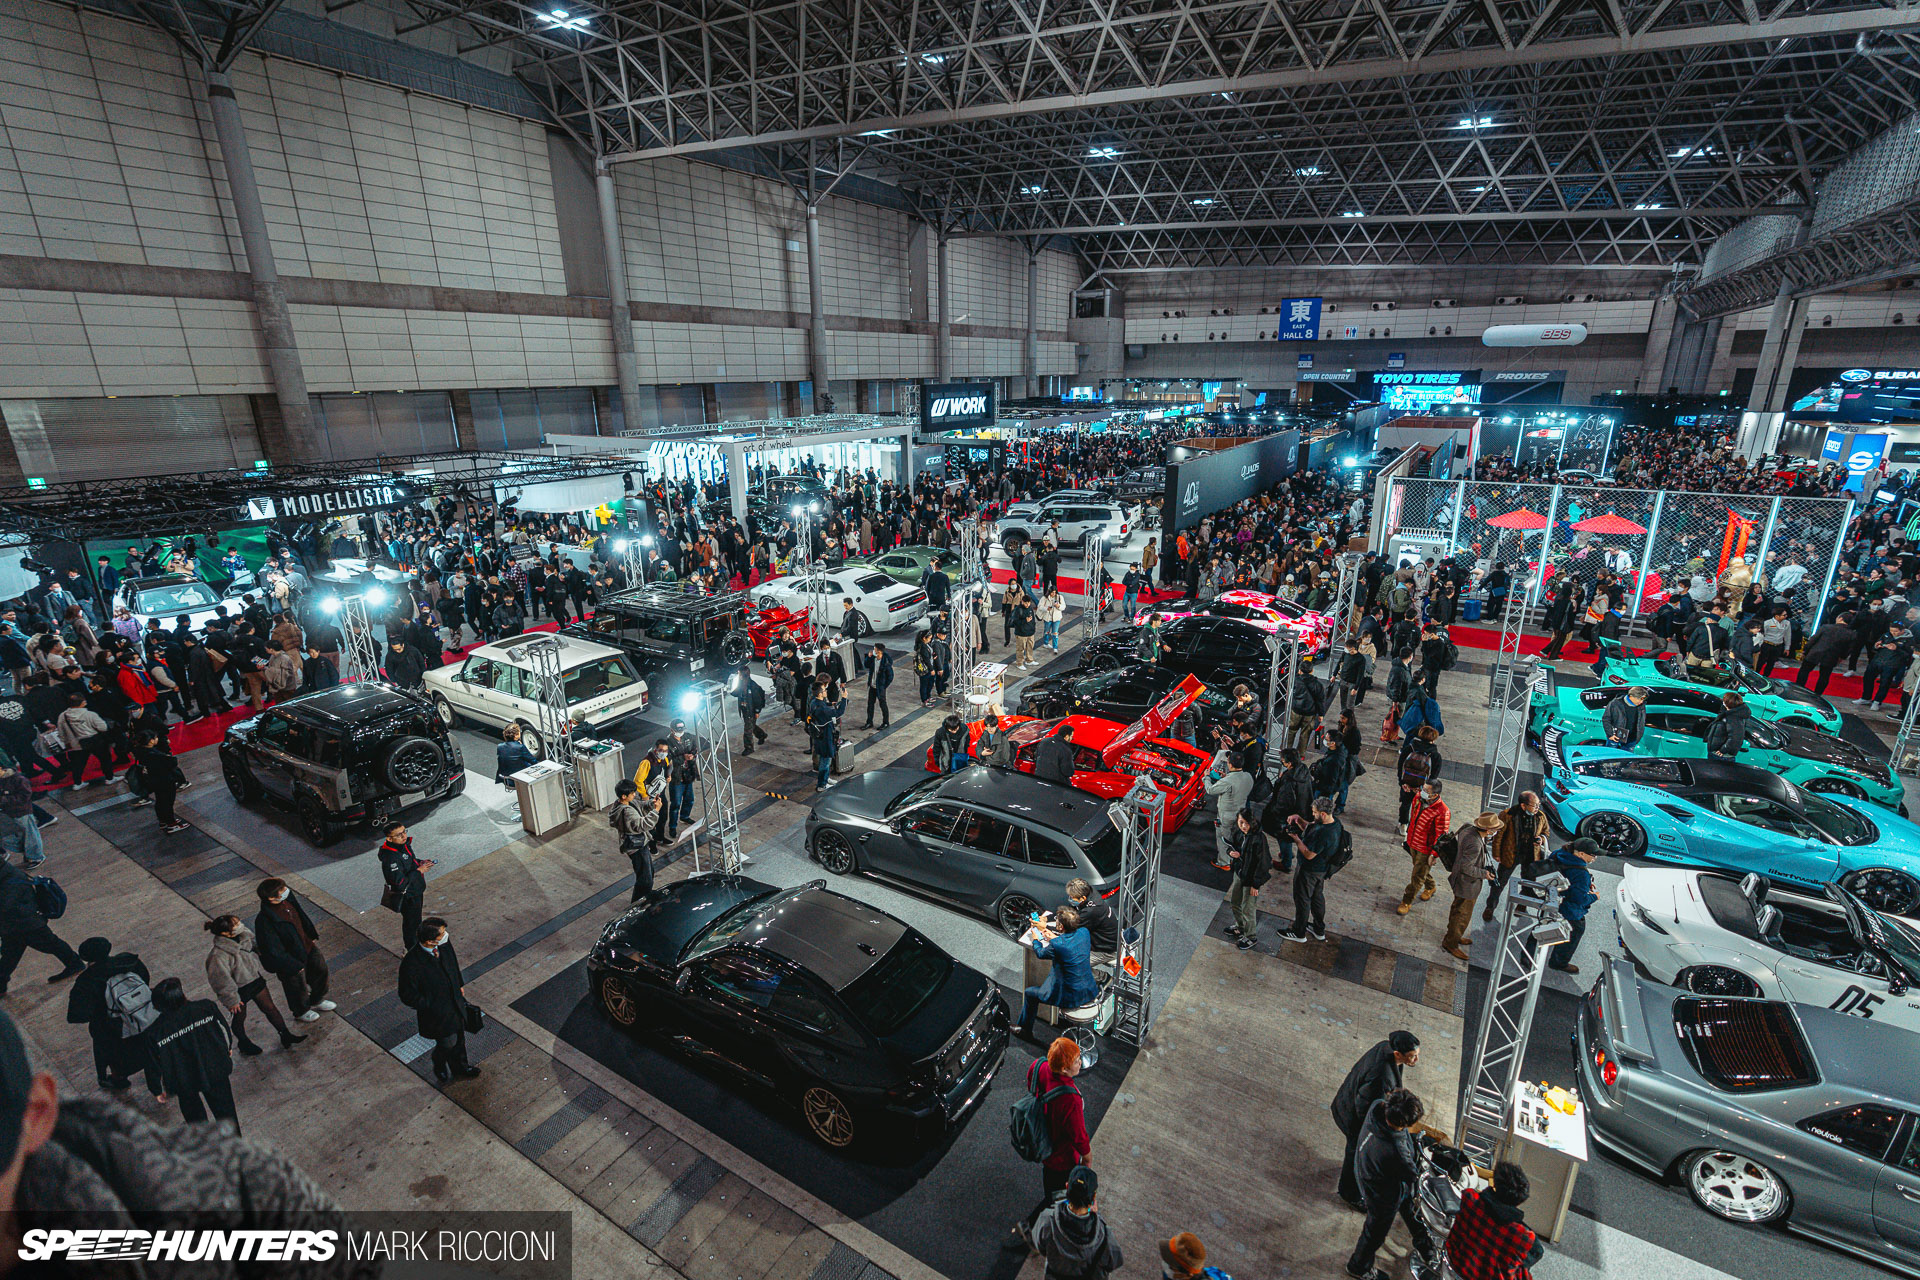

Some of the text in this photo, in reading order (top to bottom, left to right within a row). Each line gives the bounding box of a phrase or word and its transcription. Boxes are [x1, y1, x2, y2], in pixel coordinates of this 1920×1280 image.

[1289, 300, 1312, 322] 東
[1305, 329, 1313, 339] 8
[1541, 329, 1571, 339] BBS
[1373, 374, 1461, 383] TOYO TIRES
[1495, 372, 1550, 380] PROXES
[1874, 371, 1920, 379] SUBA
[950, 396, 987, 415] WORK
[672, 441, 722, 461] WORK
[743, 444, 755, 453] art
[758, 441, 767, 451] of
[282, 486, 393, 517] MODELLISTA
[584, 691, 628, 711] RANGE ROVER
[1628, 783, 1670, 799] LIBERTY WALK
[157, 1031, 178, 1047] TOKYO
